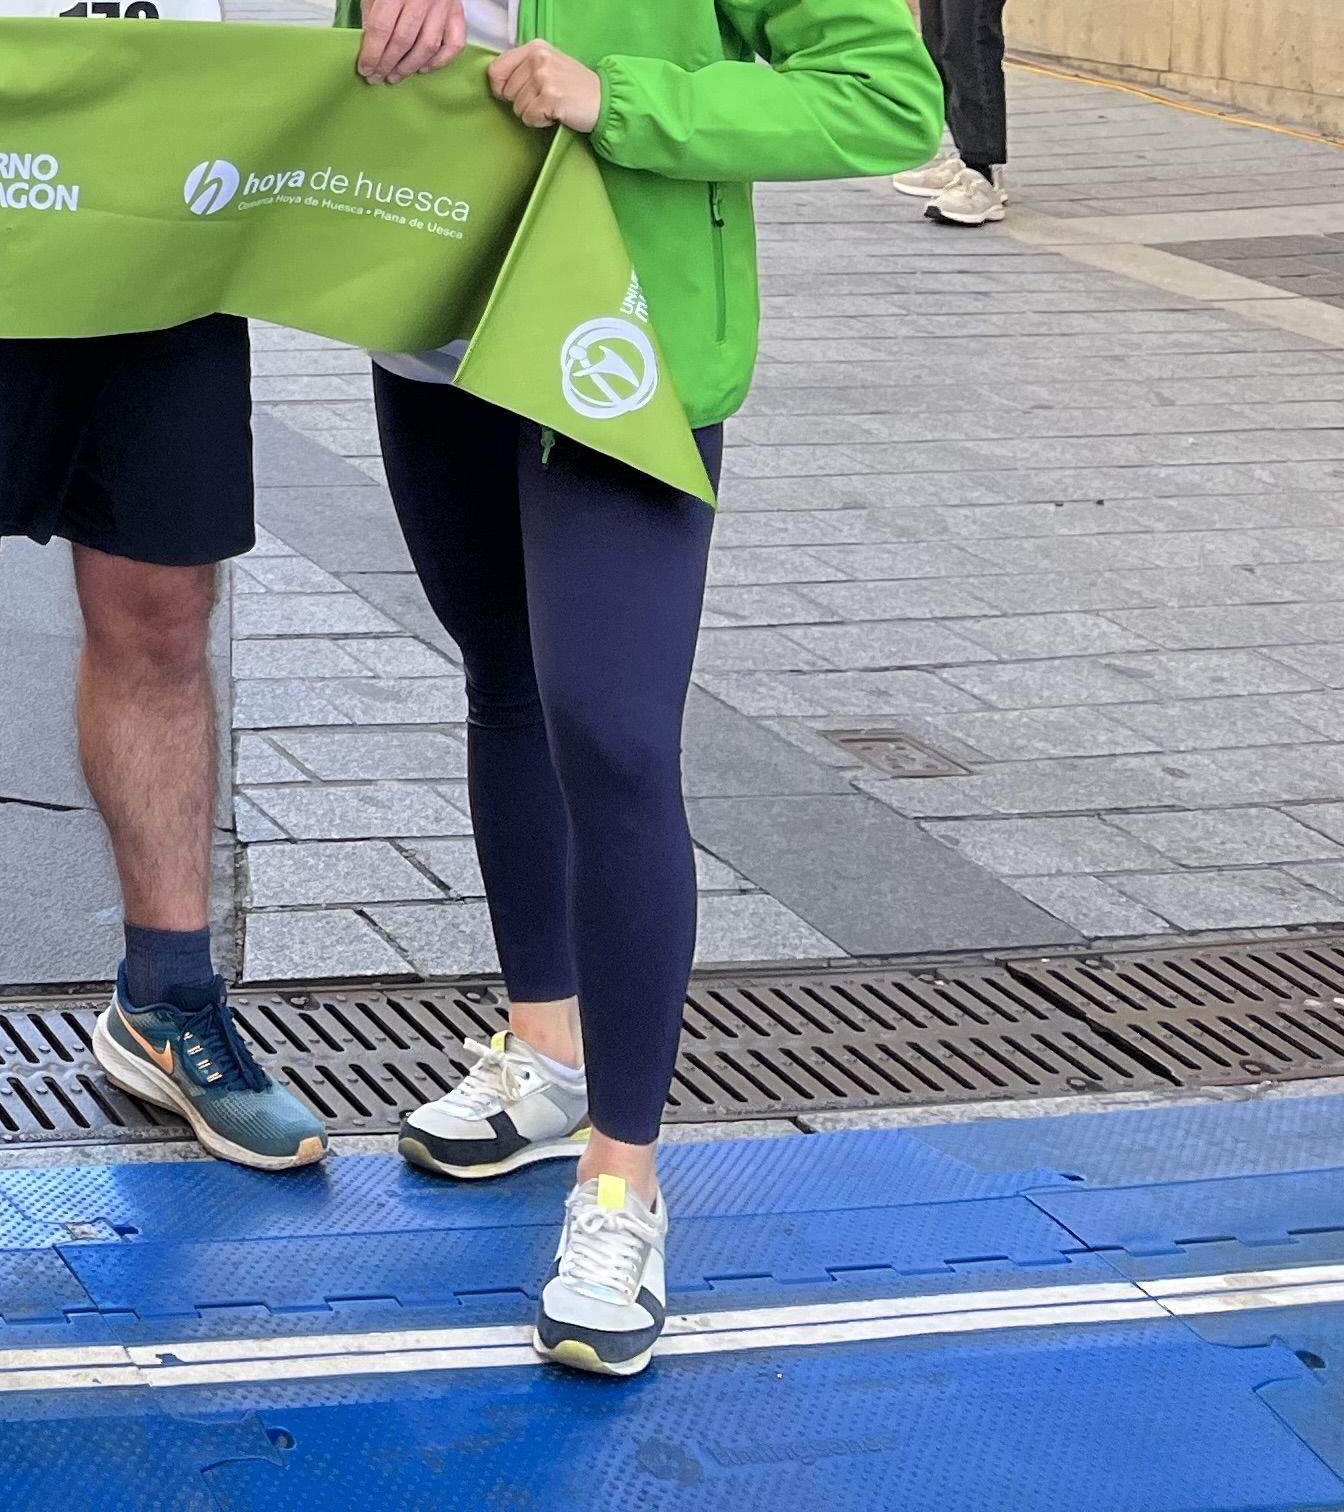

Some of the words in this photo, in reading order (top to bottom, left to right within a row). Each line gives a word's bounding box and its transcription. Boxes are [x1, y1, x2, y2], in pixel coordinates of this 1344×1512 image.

[243, 169, 306, 196] hoya
[310, 166, 349, 194] de
[353, 171, 471, 223] huesca
[321, 199, 364, 215] Huesca
[373, 208, 406, 224] Plana
[409, 215, 424, 230] de
